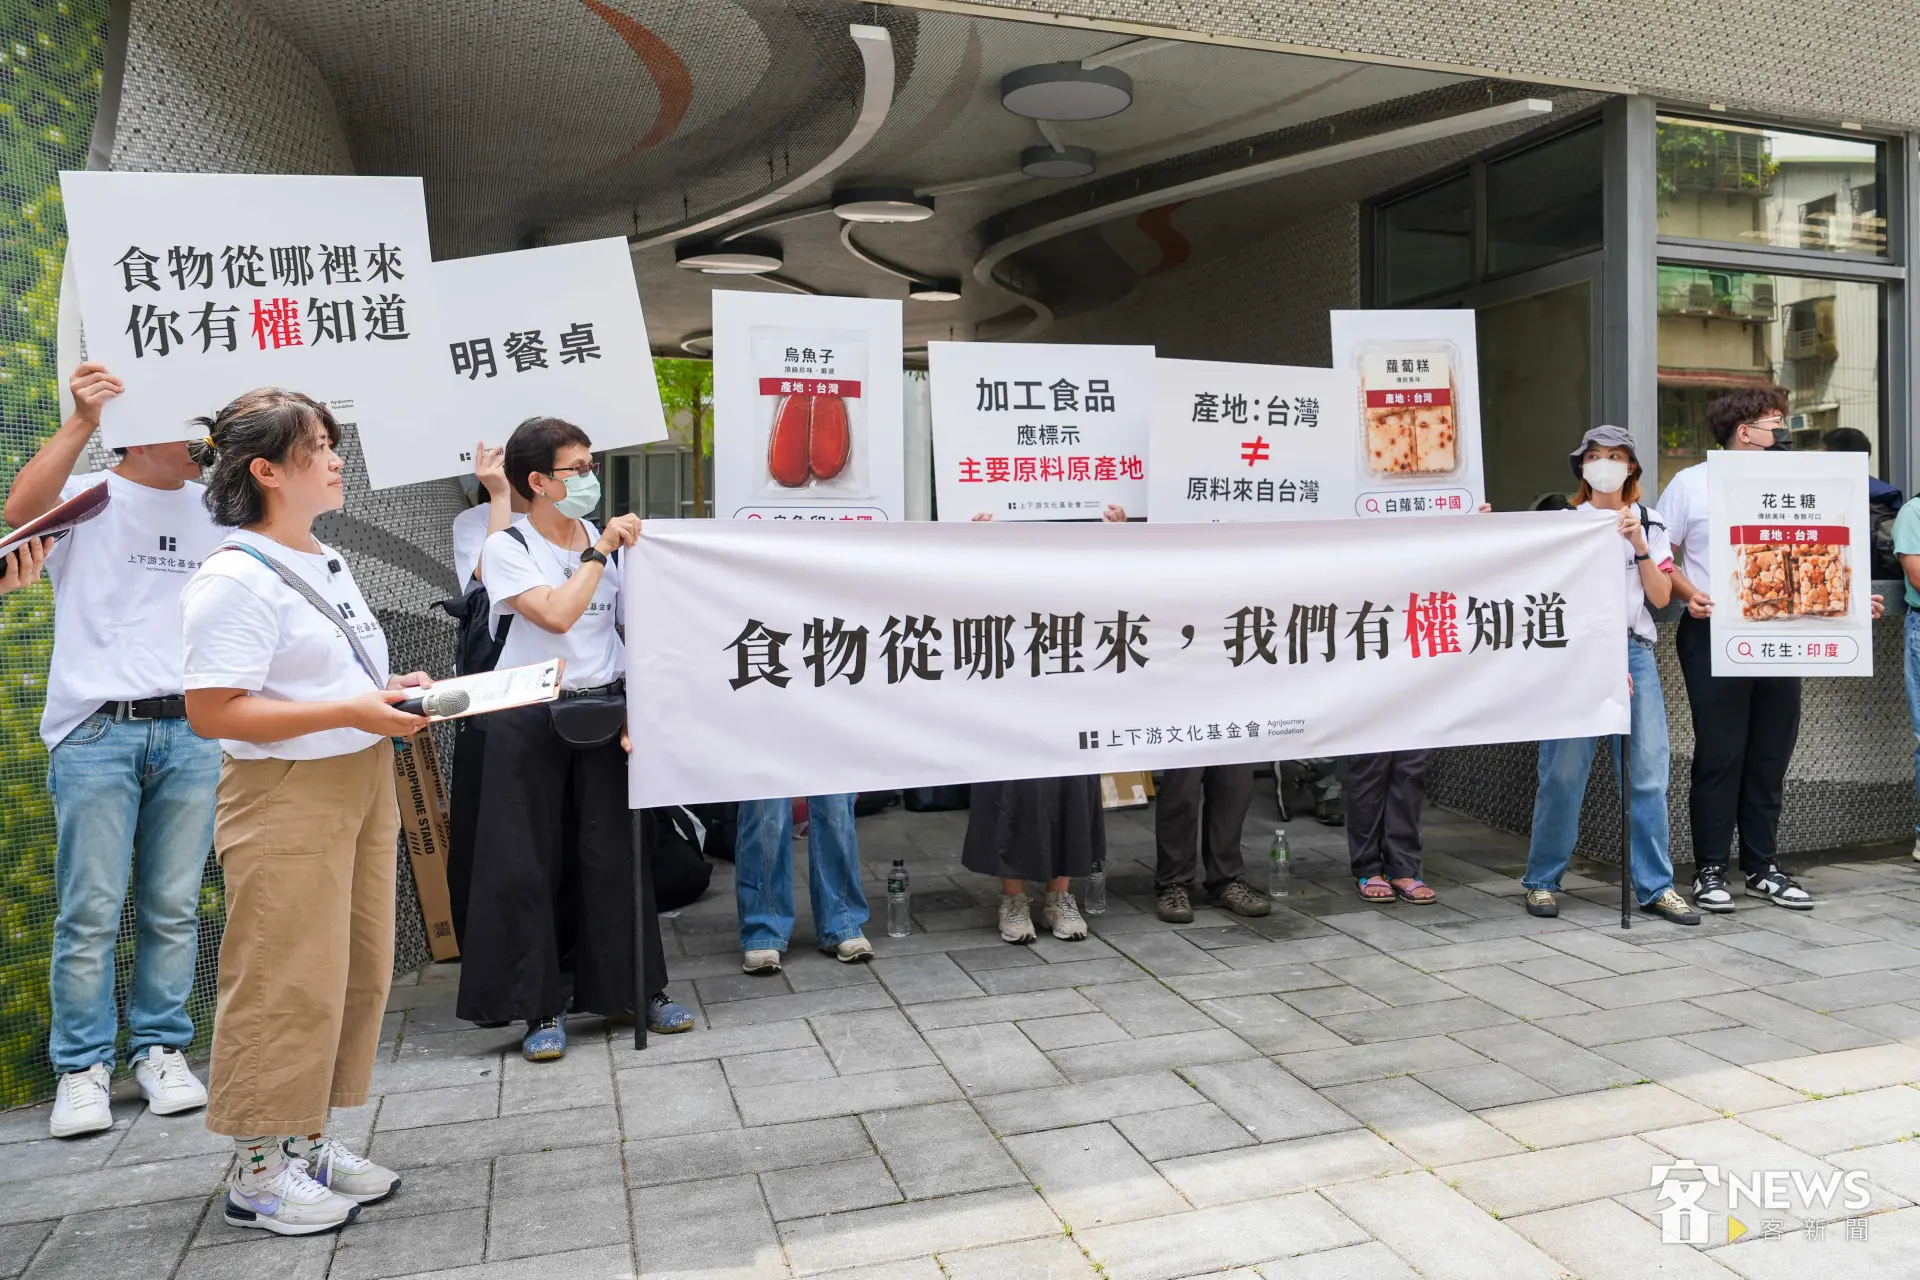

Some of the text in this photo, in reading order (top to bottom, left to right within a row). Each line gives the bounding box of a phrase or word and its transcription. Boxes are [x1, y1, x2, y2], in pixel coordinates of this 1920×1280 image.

[113, 243, 405, 293] 食物從哪裡來
[125, 293, 412, 359] 你有權知道
[450, 322, 602, 381] 明餐桌
[784, 346, 835, 364] 烏魚子
[1386, 358, 1430, 374] 蘿蔔糕
[976, 378, 1116, 413] 加工食品
[1017, 423, 1081, 446] 應標示
[958, 455, 1145, 484] 主要原料原產地
[1186, 476, 1320, 504] 原料來自台灣
[1761, 493, 1816, 509] 花生糖
[1106, 720, 1261, 747] 上下游文化基金會
[1268, 727, 1304, 736] Foundation
[418, 818, 436, 855] STAND
